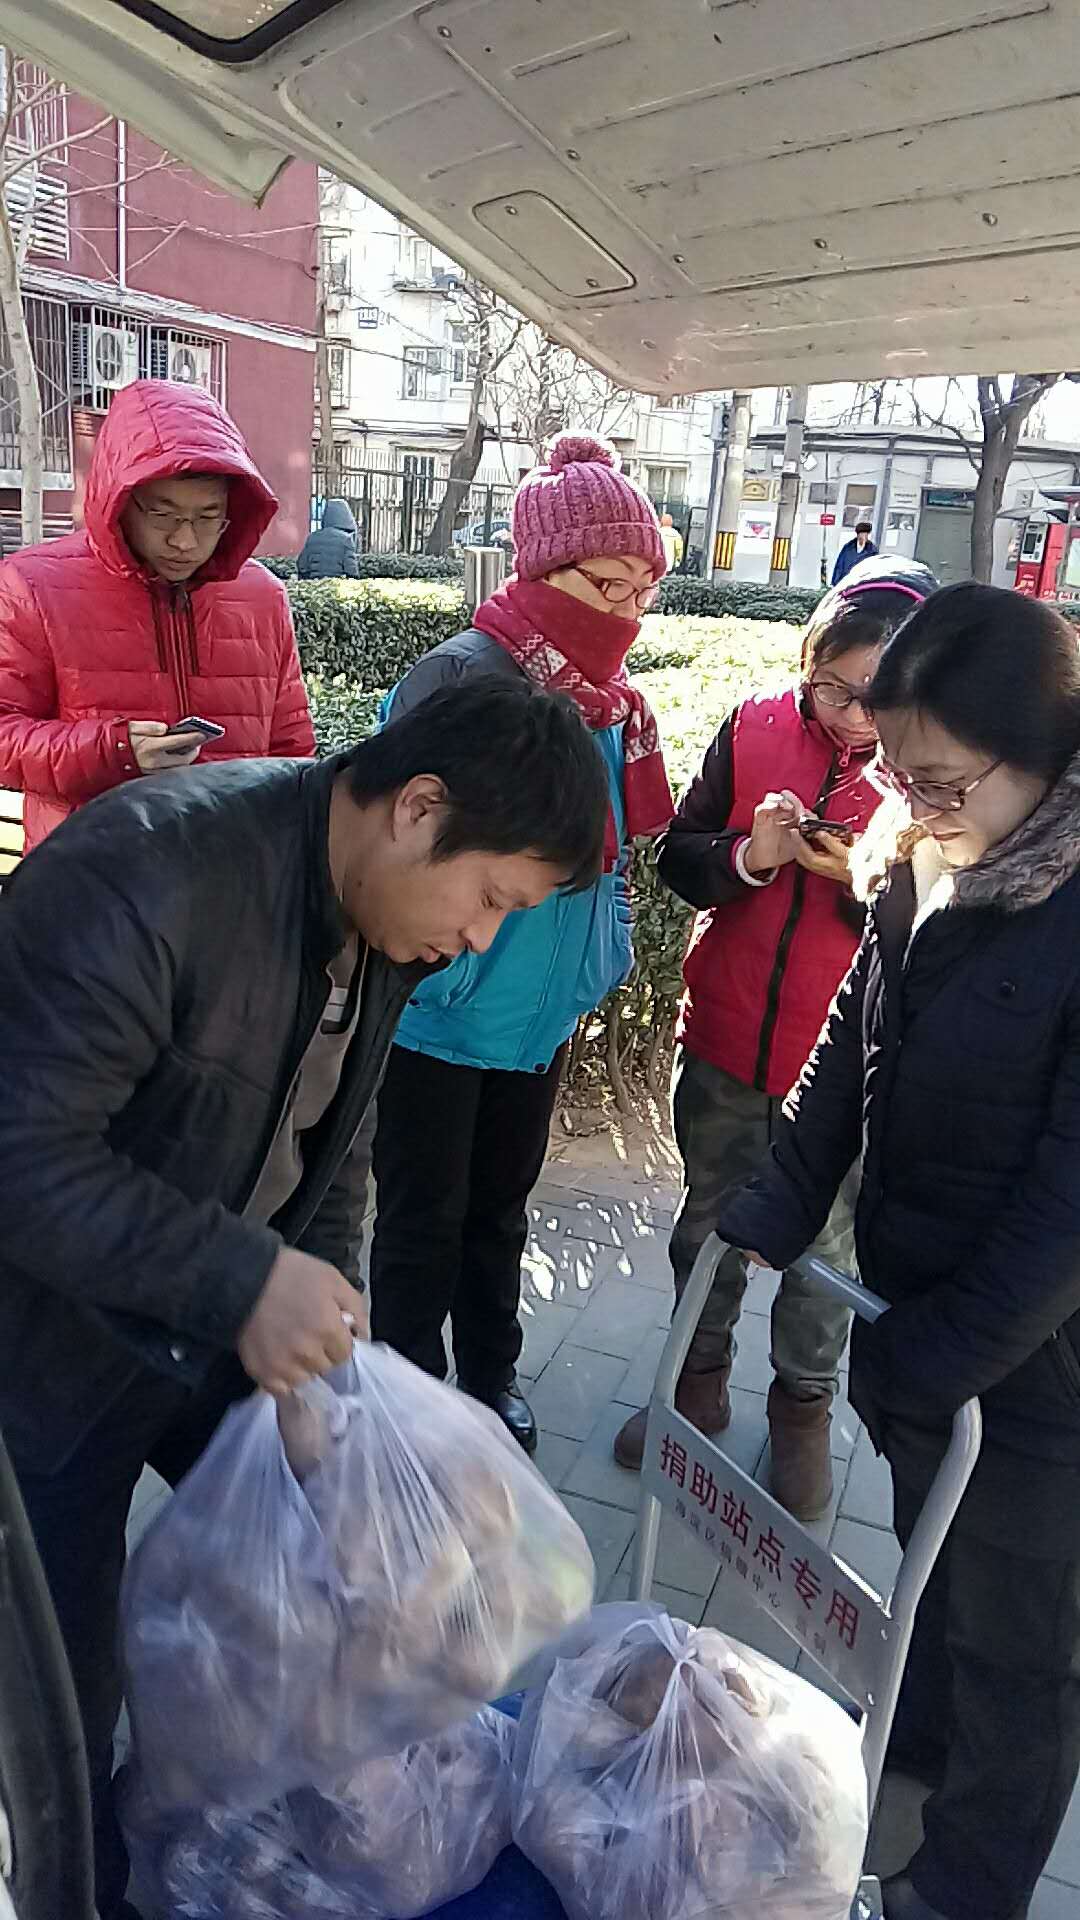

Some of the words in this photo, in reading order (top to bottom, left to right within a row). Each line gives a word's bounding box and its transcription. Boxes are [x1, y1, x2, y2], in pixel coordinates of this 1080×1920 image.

[660, 1433, 859, 1649] 捐助站点专用
